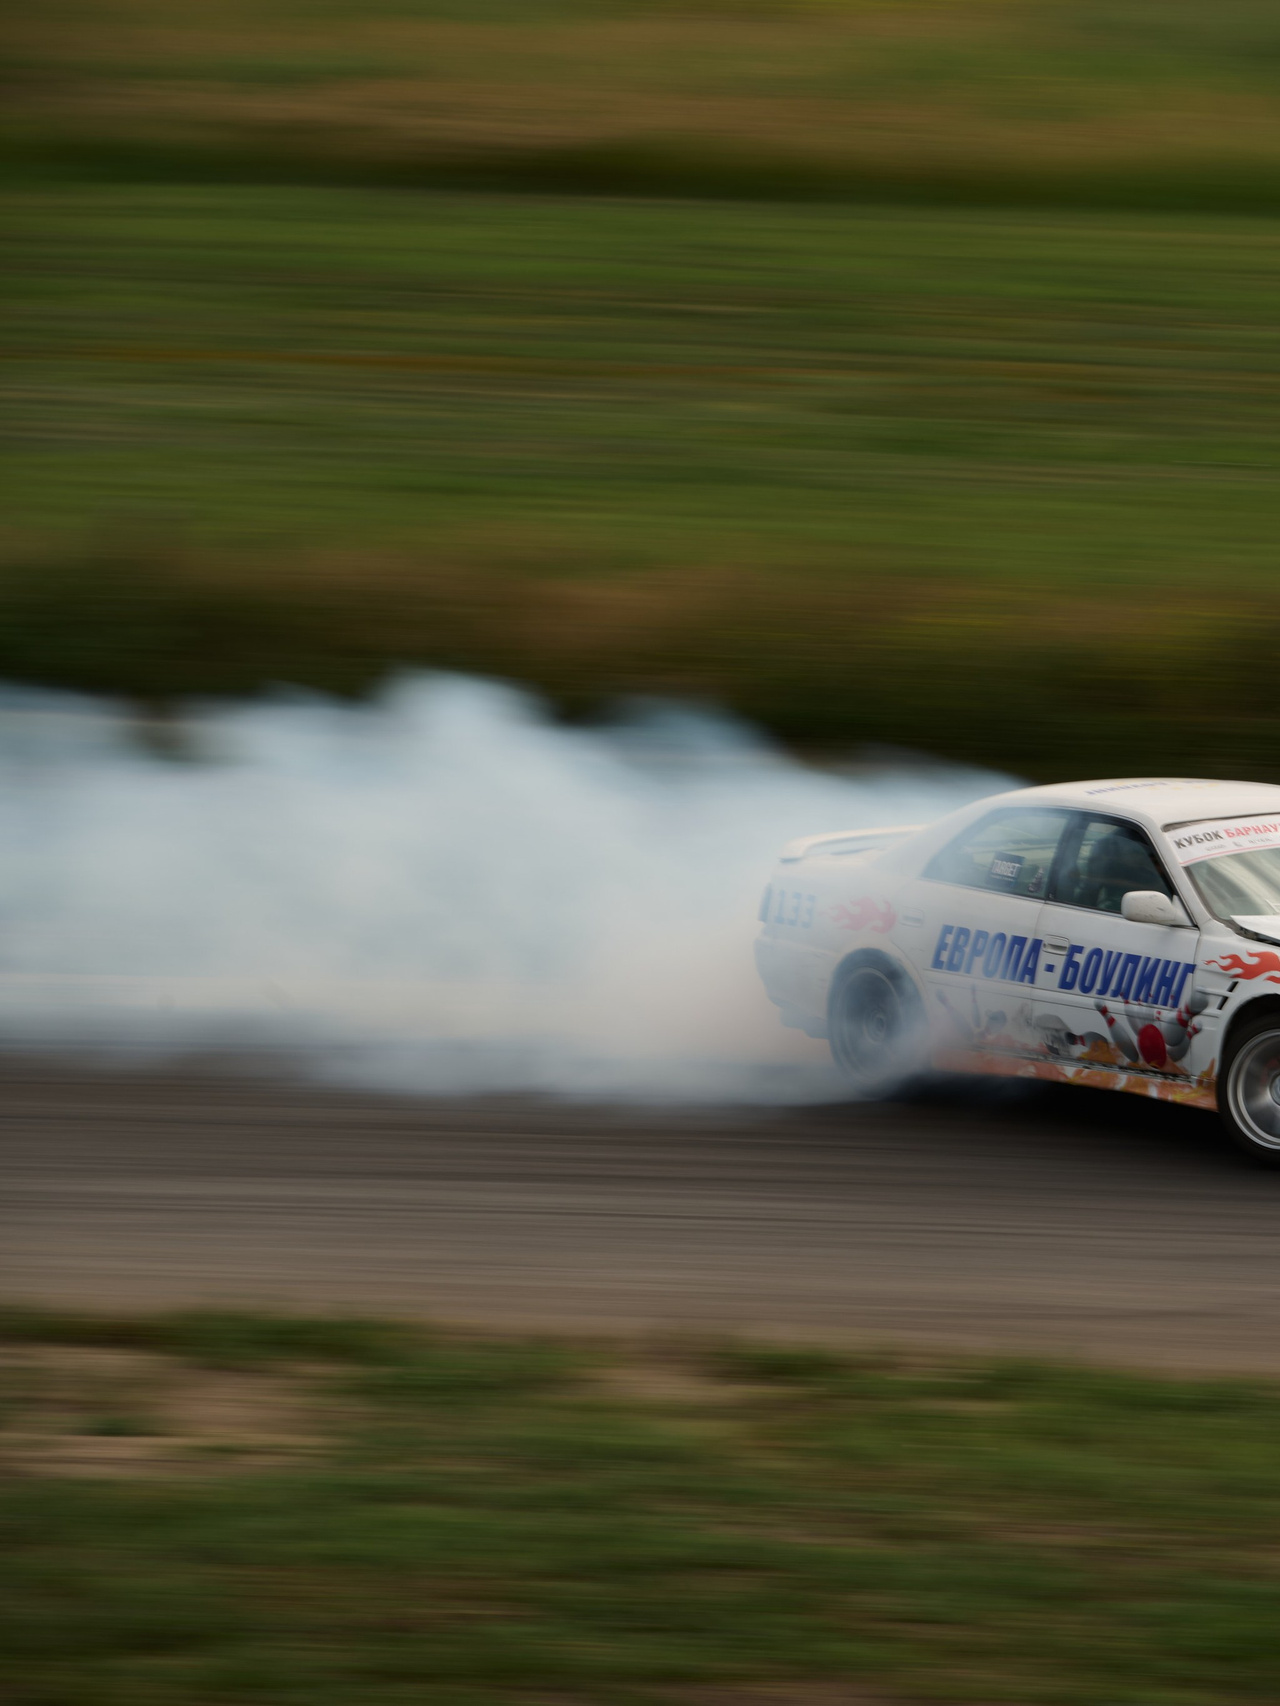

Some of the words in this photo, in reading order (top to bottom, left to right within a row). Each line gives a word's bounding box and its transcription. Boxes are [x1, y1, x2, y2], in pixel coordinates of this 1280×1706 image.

[1174, 830, 1224, 849] КУБОК
[930, 923, 1043, 985] ЕВРОПА
[1057, 944, 1197, 1009] БОУЛИНГ
